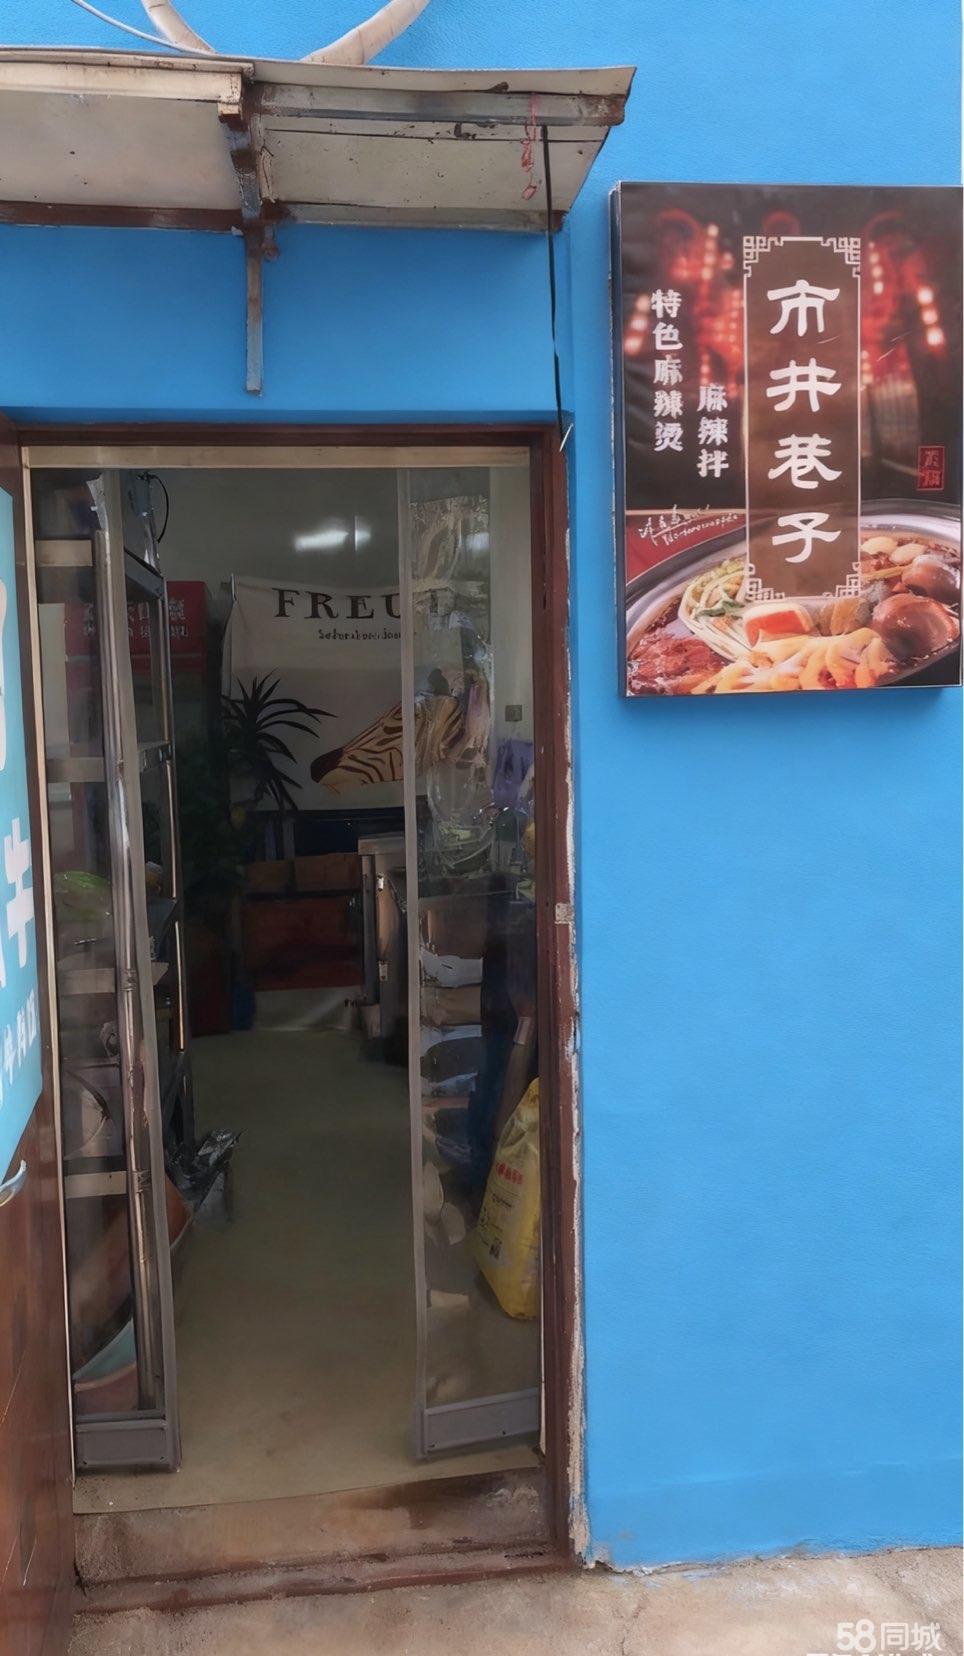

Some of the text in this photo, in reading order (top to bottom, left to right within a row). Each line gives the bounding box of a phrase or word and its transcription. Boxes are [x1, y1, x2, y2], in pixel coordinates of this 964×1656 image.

[650, 288, 684, 452] 特色麻辣烫
[697, 382, 730, 479] 麻辣拌
[766, 279, 842, 563] 市井巷子
